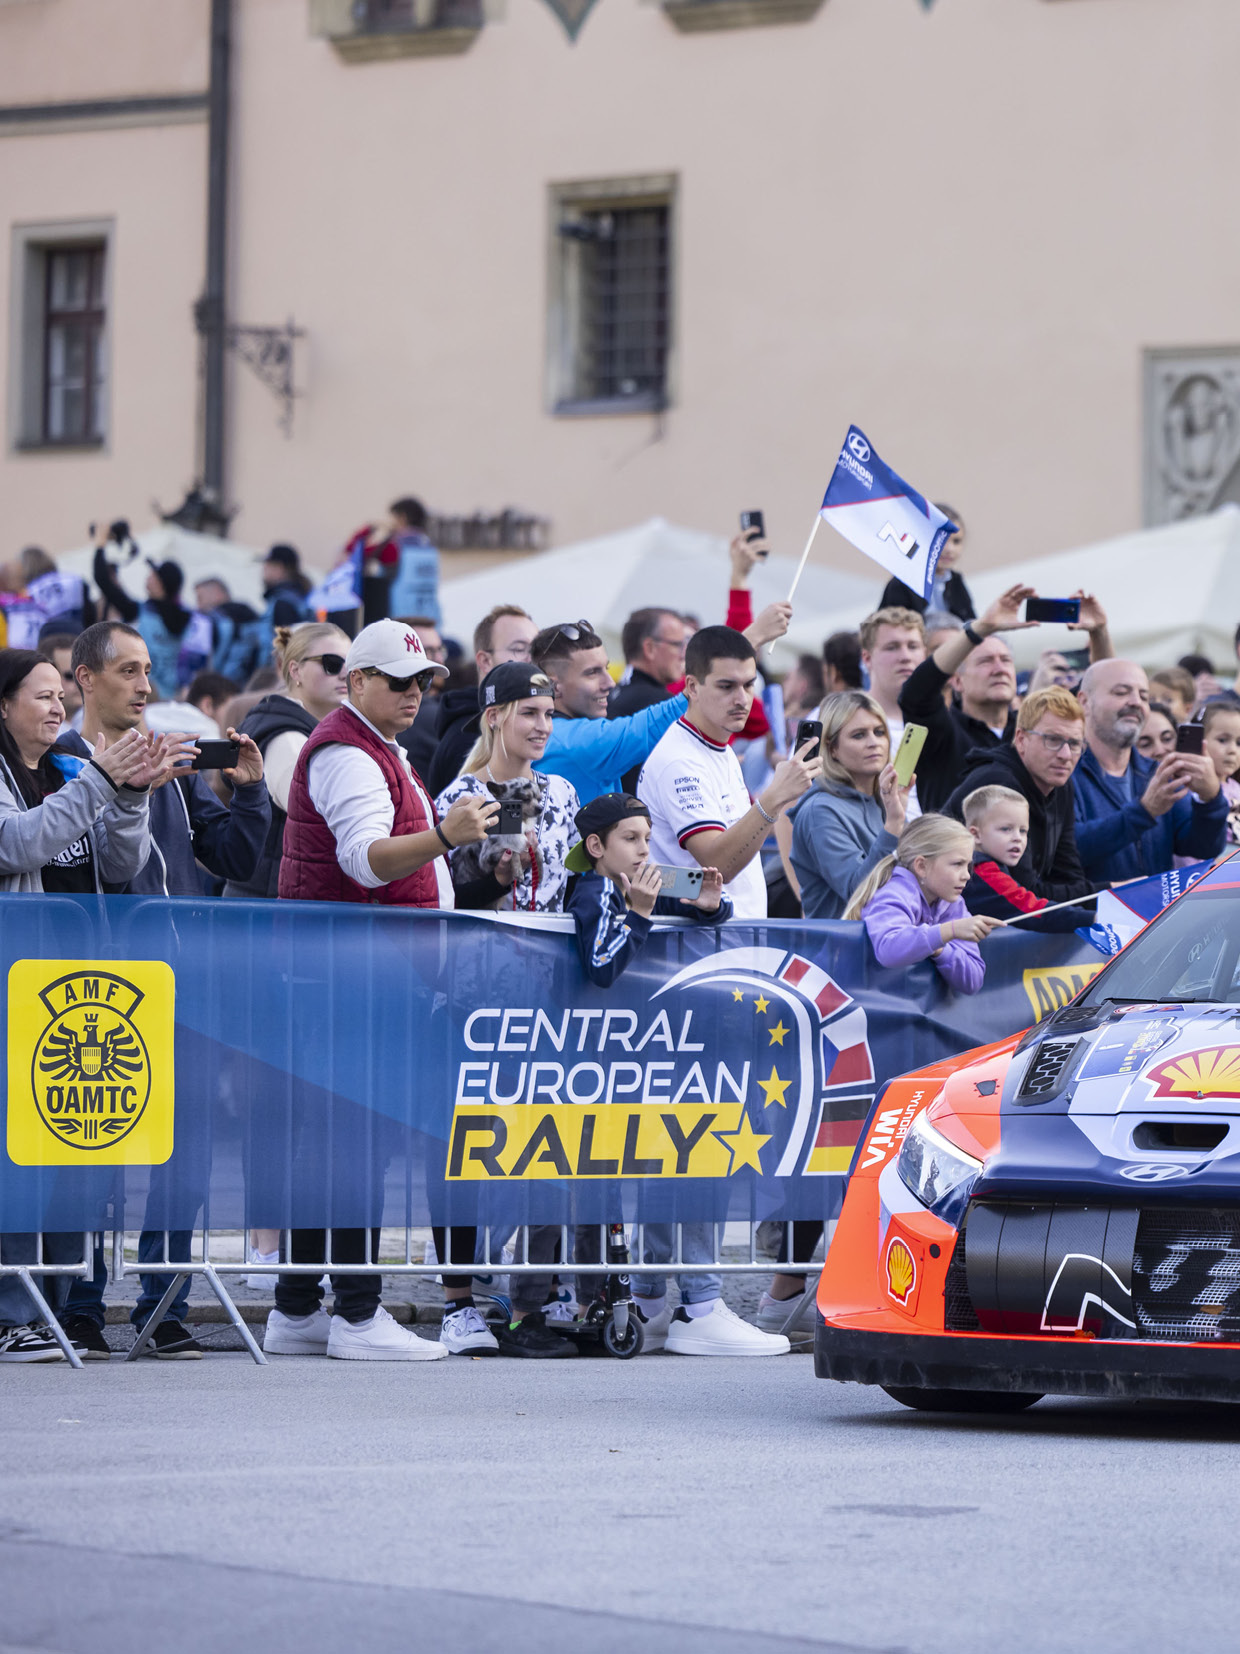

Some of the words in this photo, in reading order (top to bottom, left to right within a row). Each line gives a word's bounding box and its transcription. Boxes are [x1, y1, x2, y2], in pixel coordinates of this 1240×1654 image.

[674, 776, 700, 785] EPSON
[65, 979, 120, 1005] AMF
[1032, 970, 1099, 1015] ADA
[463, 1008, 705, 1052] CENTRAL
[46, 1085, 138, 1114] ÖAMTC
[455, 1061, 751, 1105] EUROPEAN
[895, 1090, 925, 1139] HYUNDAI
[448, 1114, 719, 1177] RALLY
[861, 1108, 904, 1170] WIA
